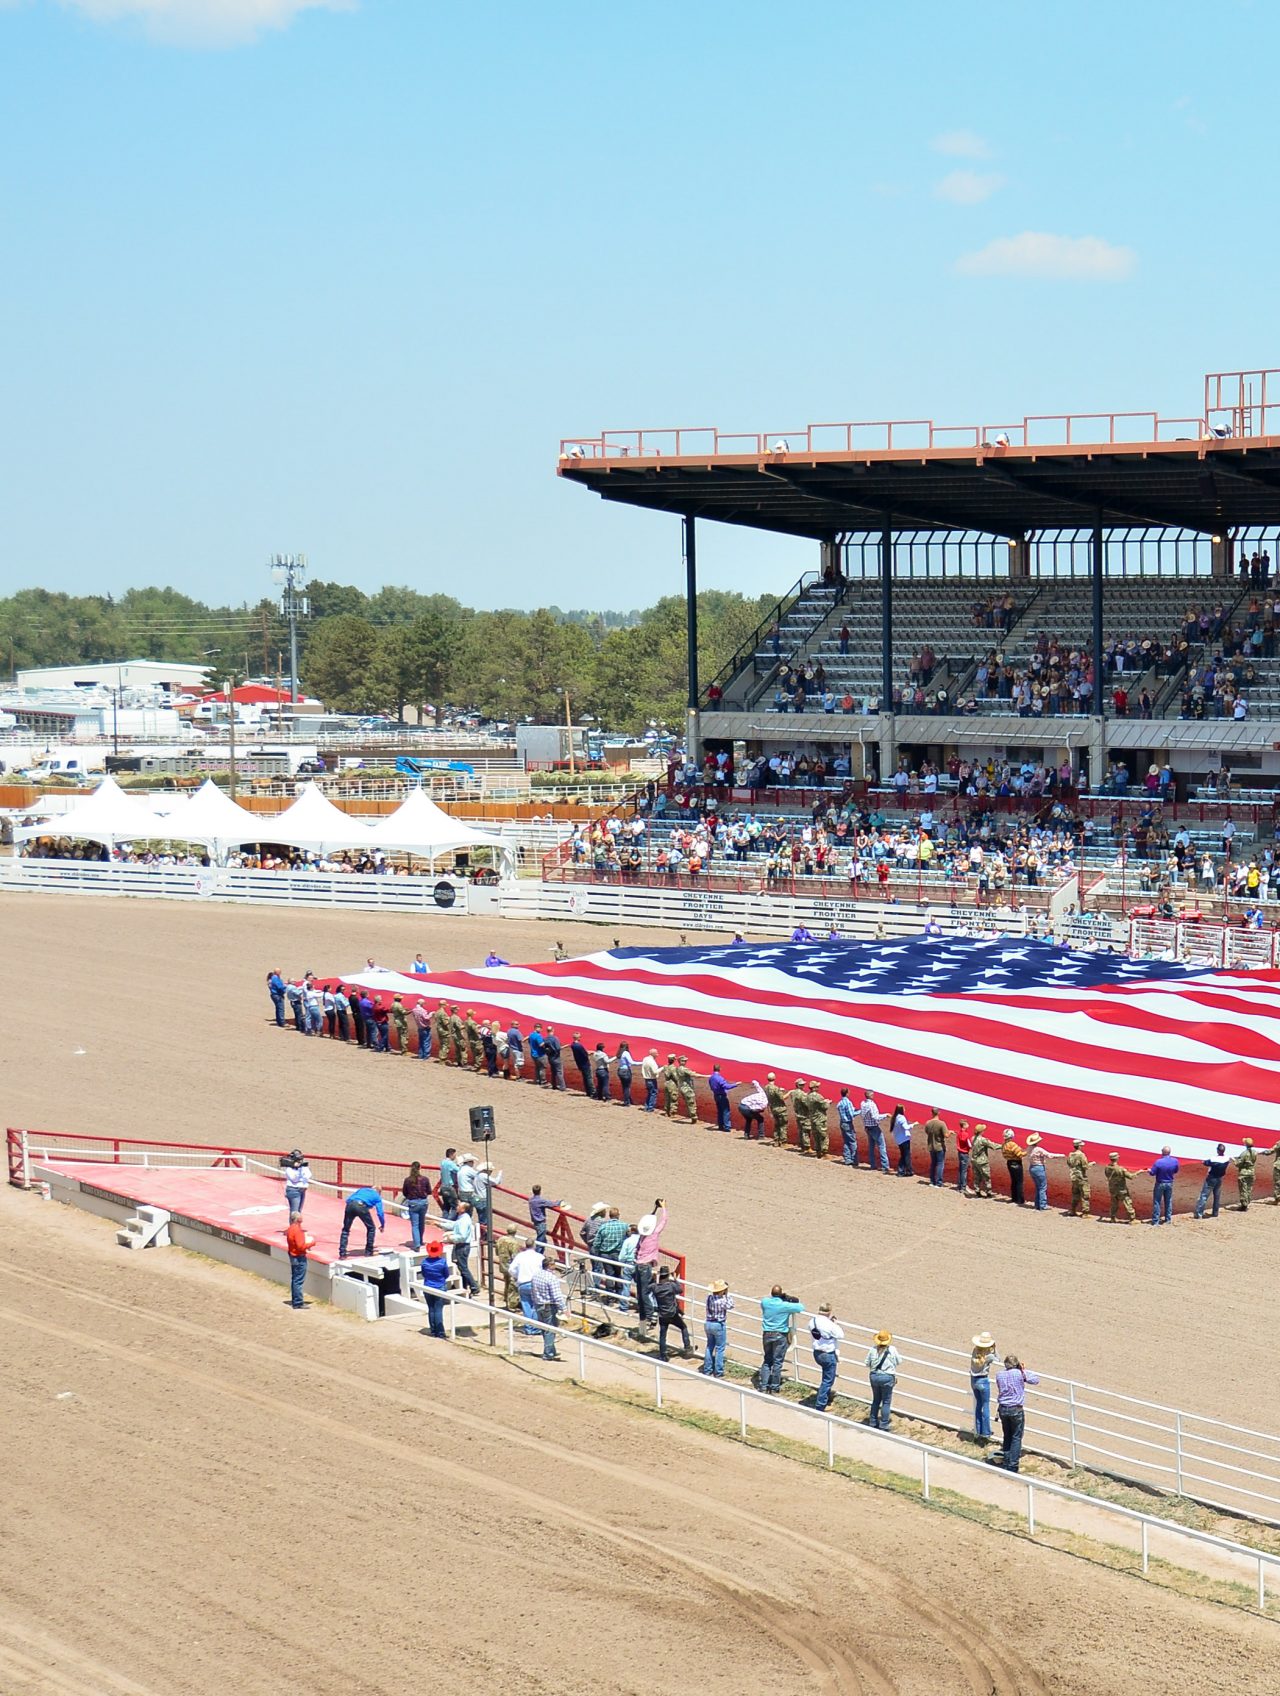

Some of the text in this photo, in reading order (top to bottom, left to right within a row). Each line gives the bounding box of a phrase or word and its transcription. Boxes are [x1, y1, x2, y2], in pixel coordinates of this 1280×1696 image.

[683, 892, 724, 900] CHEYENNE
[683, 902, 723, 910] FRONTIER
[813, 901, 857, 909] CHEYENNE
[813, 911, 856, 919] FRONTIER
[951, 910, 997, 918] CHEYENNE
[1072, 919, 1112, 928] CHEYENNE
[1072, 929, 1112, 938] FRONTIER
